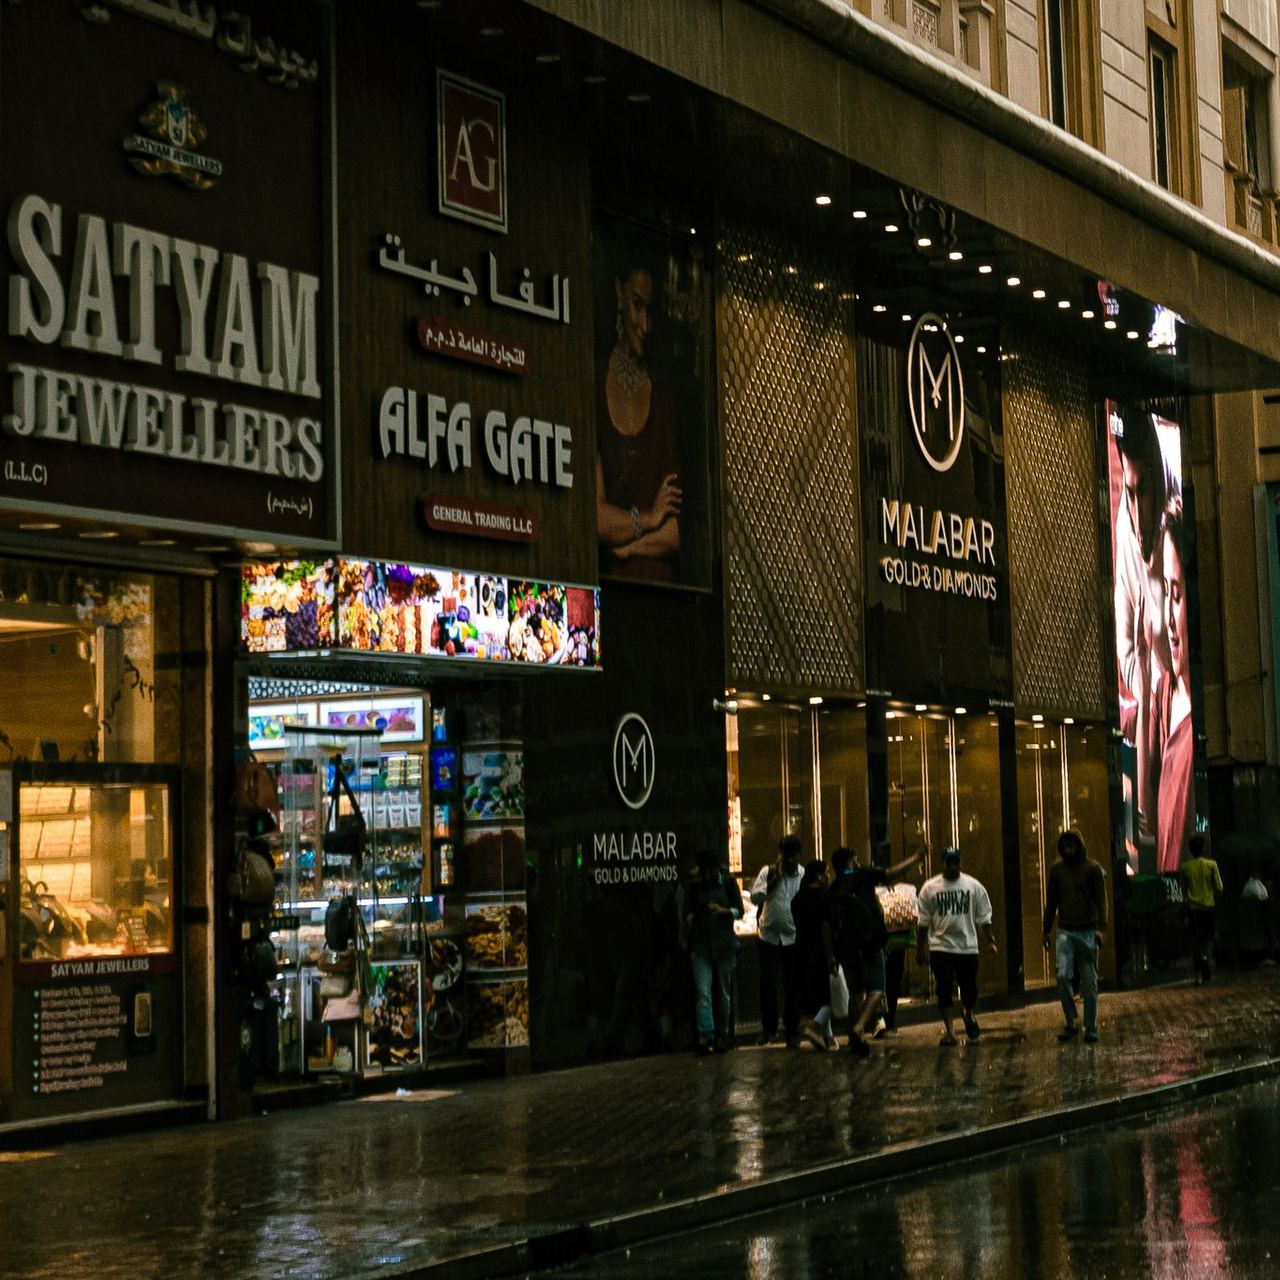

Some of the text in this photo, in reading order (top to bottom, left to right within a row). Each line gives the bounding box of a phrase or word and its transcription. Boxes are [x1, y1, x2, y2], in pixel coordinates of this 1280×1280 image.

[133, 136, 219, 173] SATYAM JEWELLERS
[450, 116, 497, 193] AG
[7, 194, 322, 399] SATYAM
[458, 330, 489, 355] العامة
[490, 341, 525, 368] للتجارة
[3, 362, 324, 483] JEWELLERS
[378, 385, 574, 489] ALFA GATE
[5, 459, 48, 486] (L.L.C)
[433, 505, 533, 535] GENERAL TRADING L.L.C
[882, 496, 997, 567] MALABAR
[882, 556, 998, 601] GOLD & DIAMONDS
[593, 831, 678, 862] MALABAR
[594, 864, 678, 885] GOLD & DIAMONDS
[51, 957, 150, 979] SATYAM JEWELLERS
